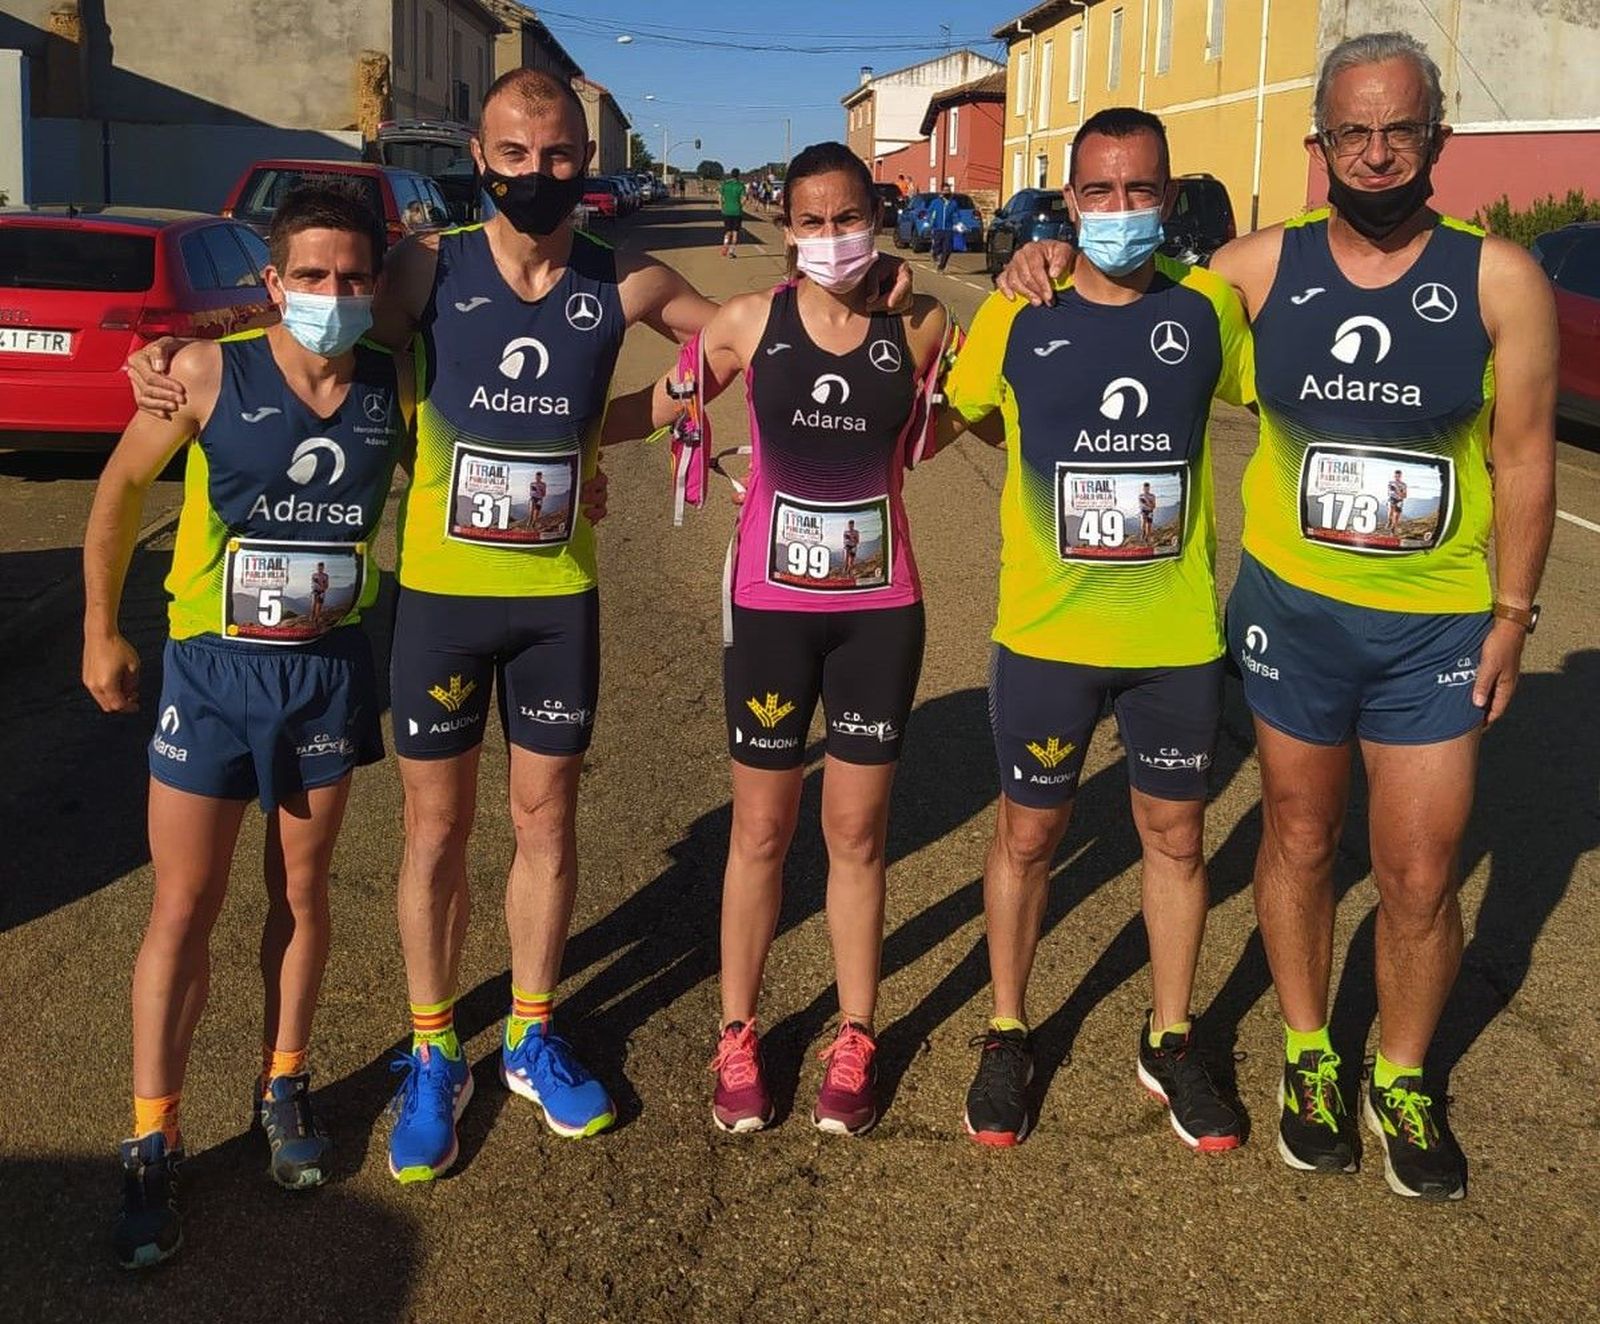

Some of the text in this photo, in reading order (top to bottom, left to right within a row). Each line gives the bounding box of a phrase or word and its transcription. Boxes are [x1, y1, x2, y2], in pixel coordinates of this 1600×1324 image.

[26, 333, 65, 351] FTR
[469, 386, 570, 415] Adarsa
[1299, 374, 1422, 406] Adarsa
[791, 409, 867, 432] Adarsa
[1073, 429, 1172, 453] Adarsa
[475, 464, 506, 478] TRAIL
[1327, 461, 1360, 475] TRAIL
[1079, 480, 1113, 493] TRAIL
[248, 494, 364, 526] Adarsa
[471, 492, 511, 530] 31
[791, 513, 820, 529] TRAIL
[1317, 491, 1379, 534] 173
[1079, 509, 1124, 548] 49
[251, 557, 287, 571] TRAIL
[787, 541, 831, 579] 99
[258, 588, 282, 627] 5
[1241, 648, 1279, 681] arsa
